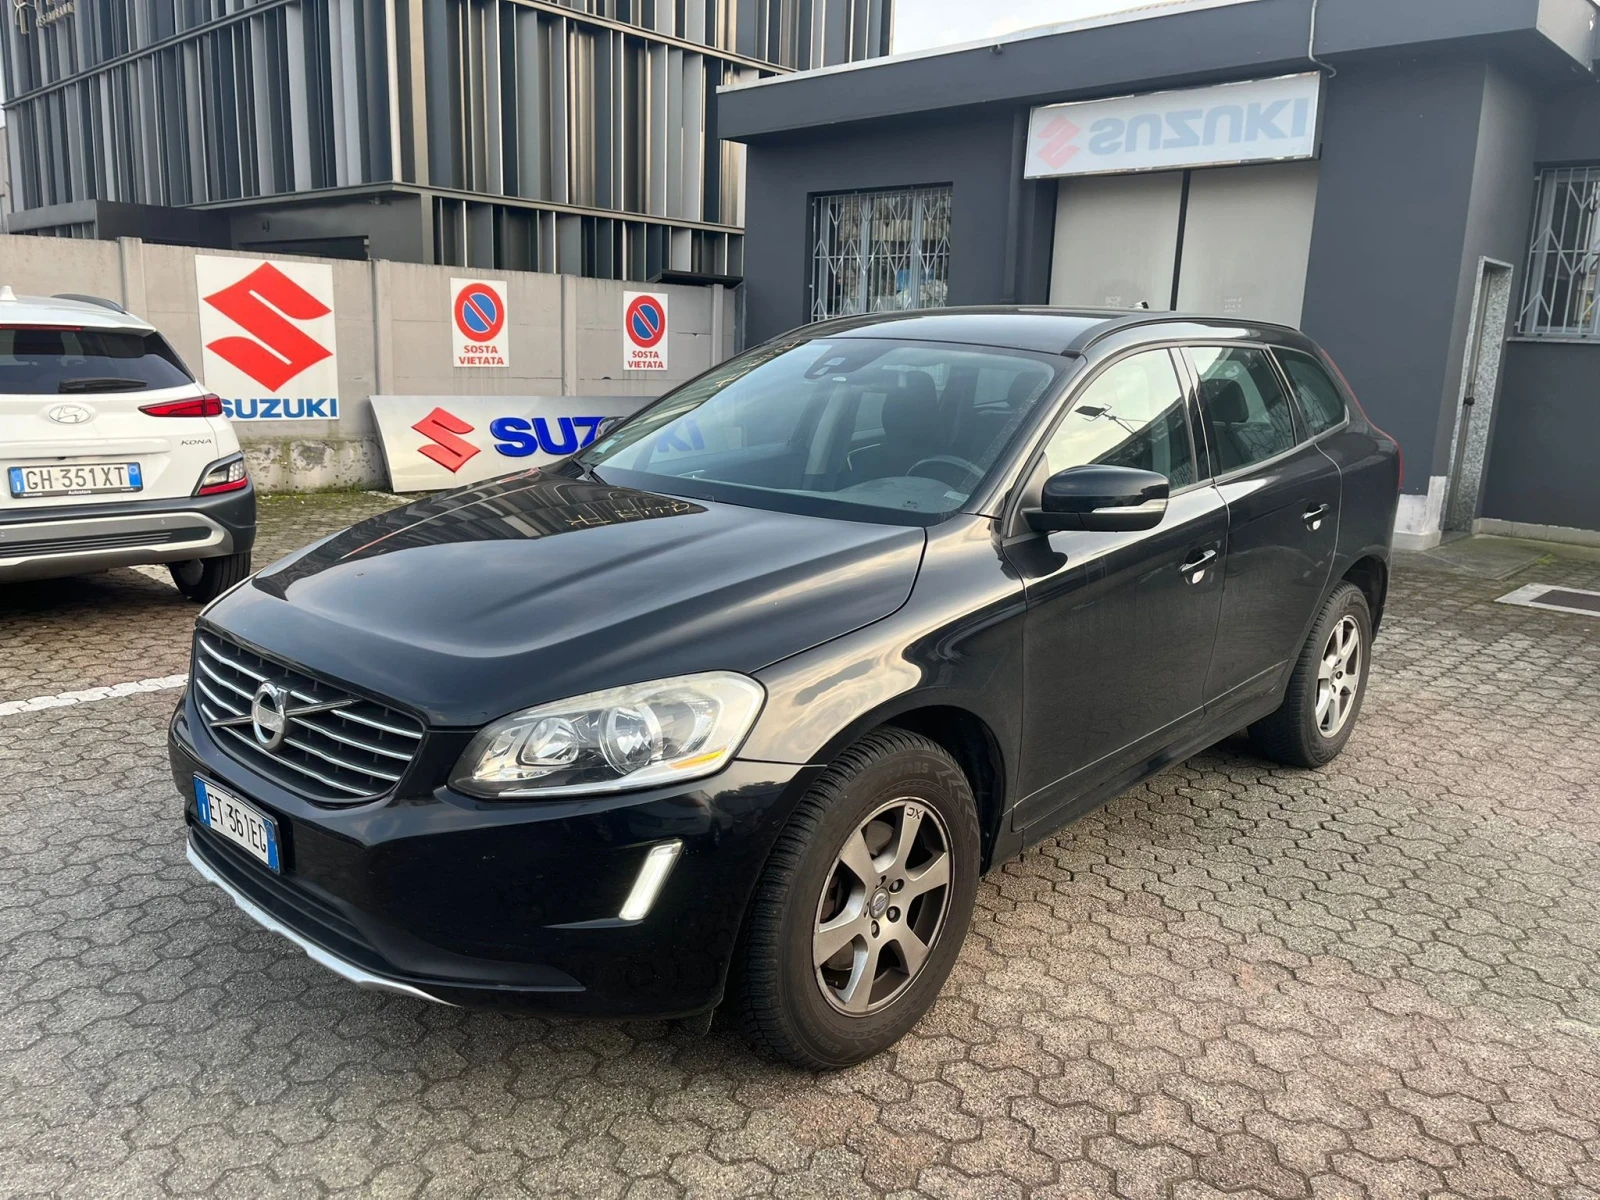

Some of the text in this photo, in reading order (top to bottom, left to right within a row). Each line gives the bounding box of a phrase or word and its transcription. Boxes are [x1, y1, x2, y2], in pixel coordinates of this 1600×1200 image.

[463, 344, 498, 354] SOSTA
[631, 350, 660, 359] SOSTA
[458, 355, 505, 365] VIETATA
[627, 360, 664, 369] VIETATA
[180, 438, 212, 446] KONA
[25, 466, 125, 490] GH 351XT
[207, 792, 267, 853] ET 361EG
